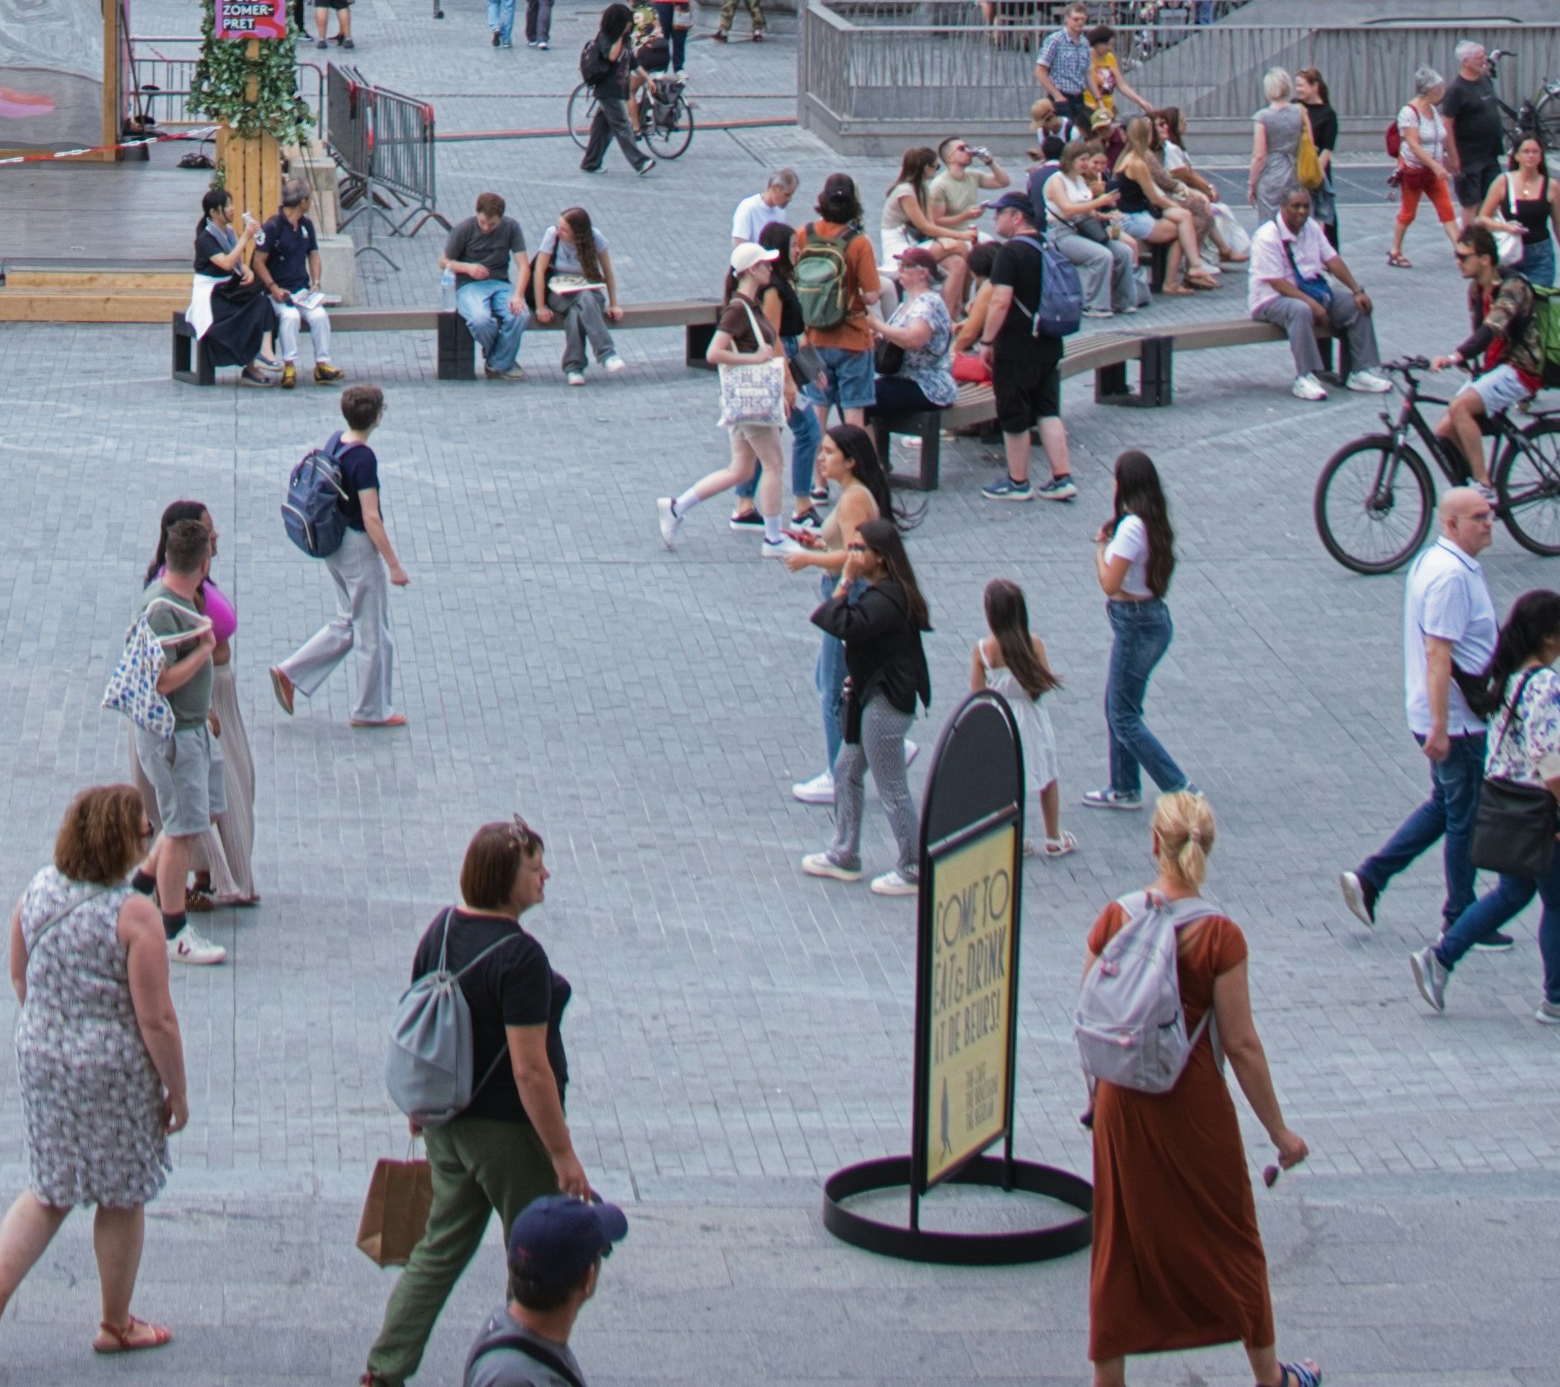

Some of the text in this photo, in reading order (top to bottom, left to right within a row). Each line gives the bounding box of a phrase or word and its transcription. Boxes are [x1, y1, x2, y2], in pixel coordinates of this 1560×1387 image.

[222, 4, 274, 16] ZOMER-
[223, 18, 255, 29] PRET
[935, 868, 1010, 956] COME TO
[934, 953, 957, 1017] EAT
[934, 987, 1001, 1068] AT DE BEURS!
